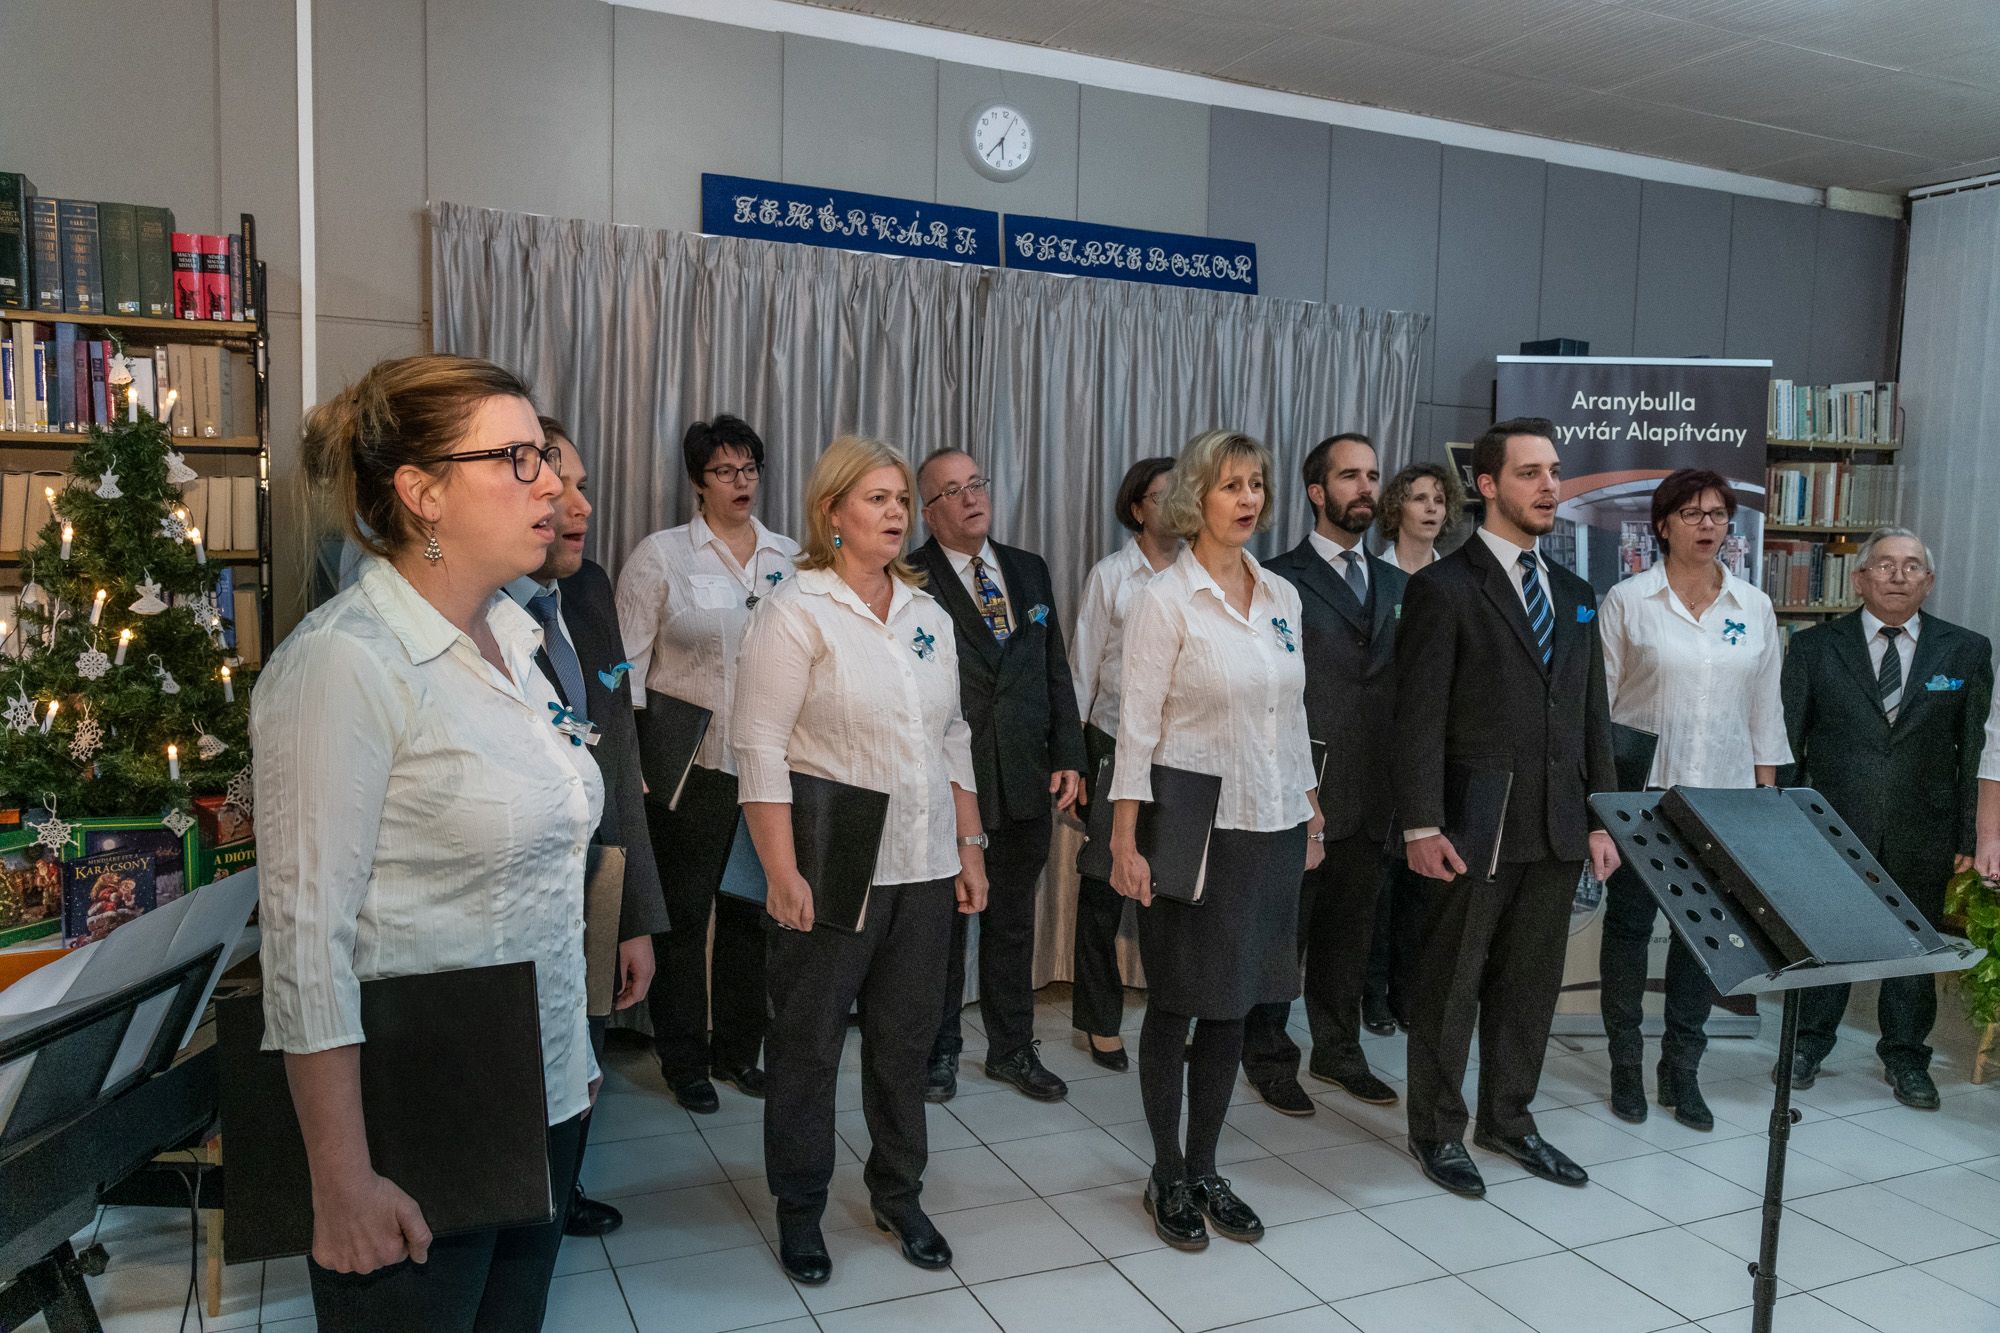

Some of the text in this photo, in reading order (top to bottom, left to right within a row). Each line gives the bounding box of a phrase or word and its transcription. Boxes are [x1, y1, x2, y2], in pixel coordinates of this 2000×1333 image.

[991, 111, 998, 120] 11
[1002, 111, 1010, 120] 12
[981, 118, 989, 126] 10
[976, 129, 982, 137] 9
[1020, 128, 1026, 137] 2
[978, 142, 984, 151] 8
[995, 160, 1001, 168] 6
[1007, 159, 1013, 168] 5
[1571, 390, 1696, 416] Aranybulla
[1625, 421, 1748, 448] Alapítvány
[213, 854, 222, 865] A
[74, 857, 150, 880] KARÁCSONY
